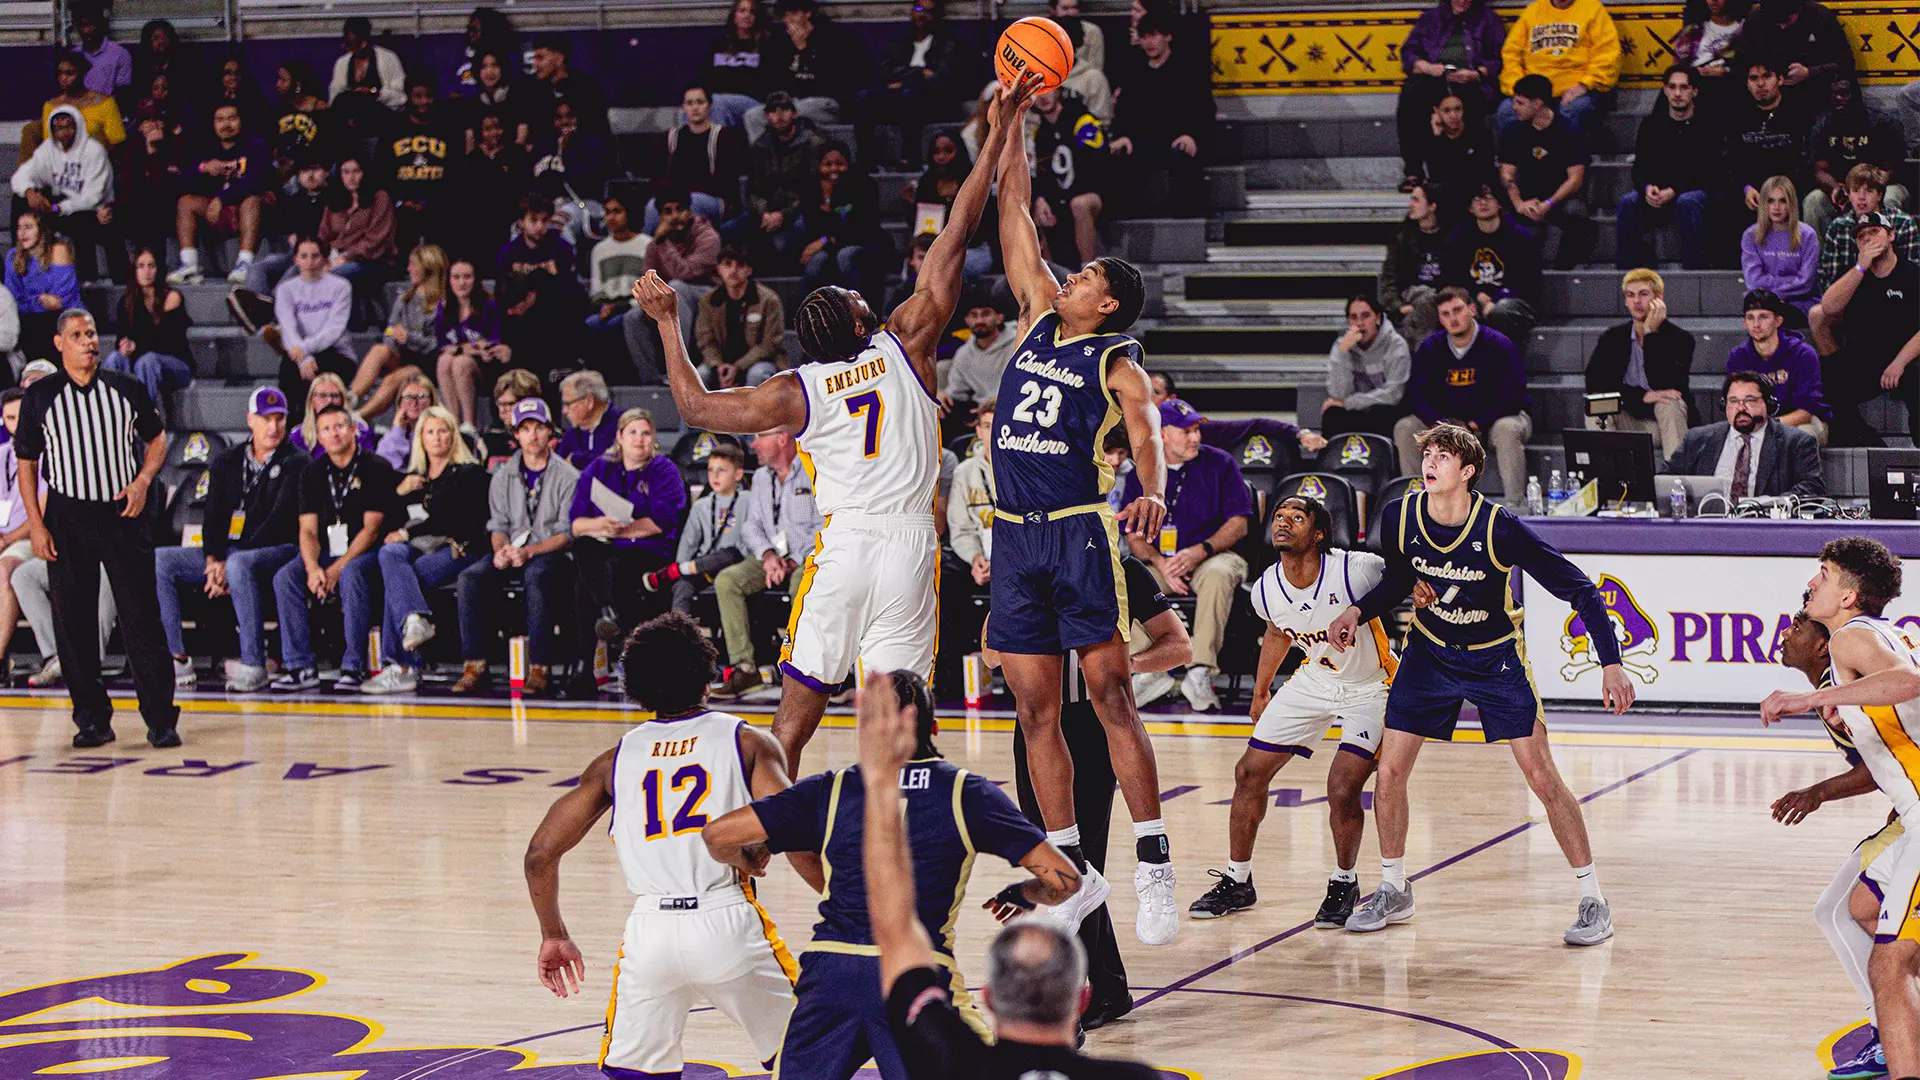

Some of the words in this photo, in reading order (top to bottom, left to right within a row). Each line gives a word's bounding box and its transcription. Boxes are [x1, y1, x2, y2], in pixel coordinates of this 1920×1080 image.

[393, 136, 447, 159] ECU
[1051, 144, 1075, 190] 9
[825, 357, 887, 395] EMEJURU
[1015, 350, 1085, 388] Charleston
[1012, 380, 1063, 428] 23
[844, 390, 886, 460] 7
[997, 424, 1069, 455] Southern
[1411, 556, 1487, 582] Charleston
[1428, 597, 1489, 625] Southern
[1440, 584, 1461, 604] 1
[1666, 610, 1793, 665] PIRA
[651, 735, 699, 757] RILEY
[898, 767, 931, 790] LER
[641, 762, 712, 842] 12
